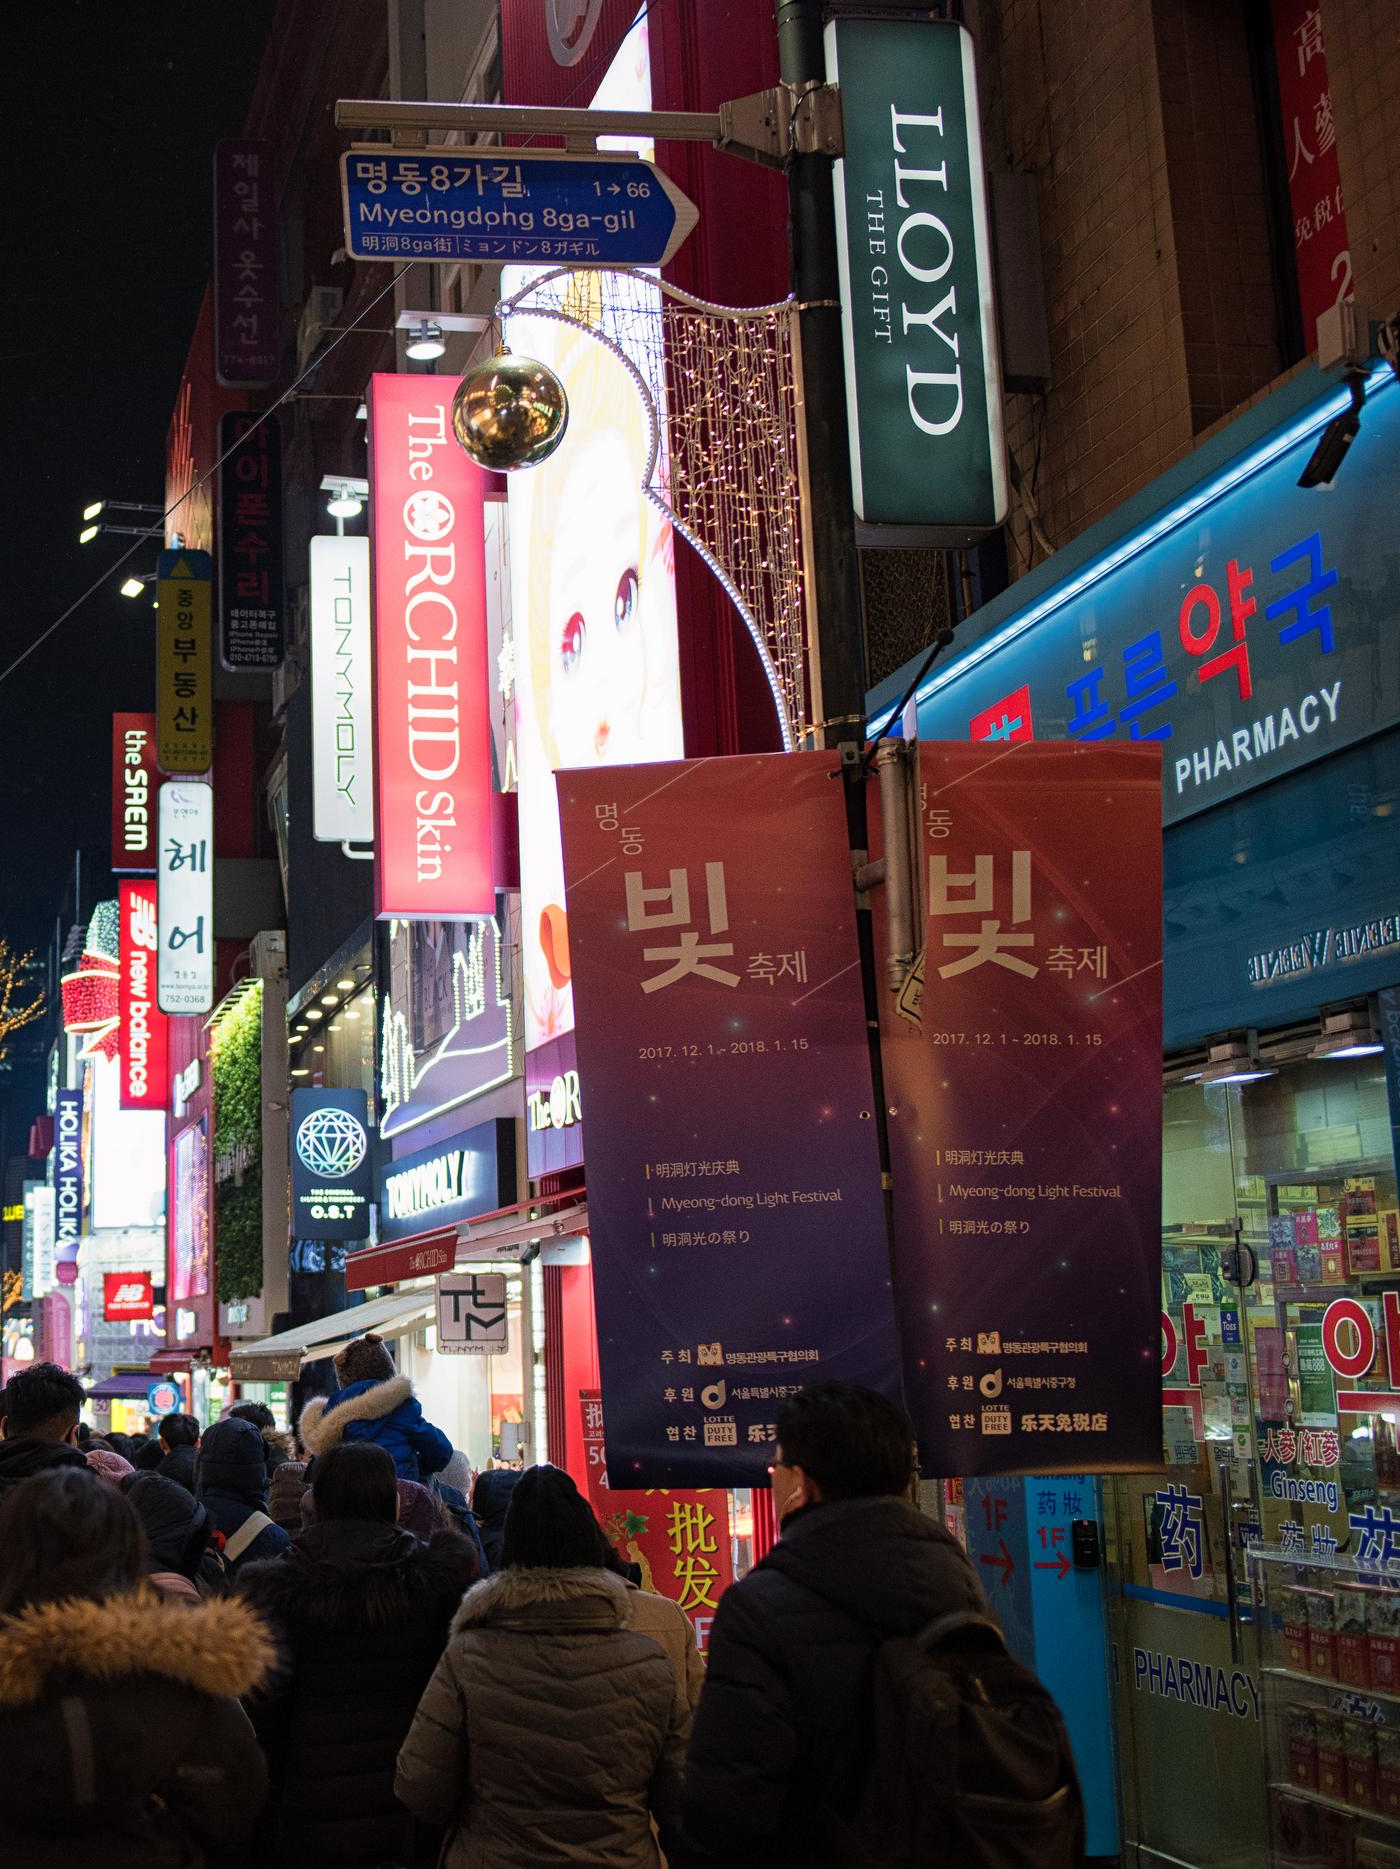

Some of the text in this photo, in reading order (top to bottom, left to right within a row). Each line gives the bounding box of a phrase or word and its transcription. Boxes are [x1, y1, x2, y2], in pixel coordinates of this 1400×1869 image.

[356, 161, 524, 198] 명동8가길
[593, 181, 651, 198] 1 66
[359, 203, 636, 233] Myeongdong 8ga-gil
[361, 234, 452, 254] 明洞8ga街
[461, 238, 600, 257] ミョンドン8ガギル
[865, 190, 893, 345] THE GIFT
[890, 103, 964, 437] LLOYD
[400, 404, 461, 884] The ORCHID Skin
[332, 566, 357, 808] TONYMOLY
[1175, 682, 1342, 793] PHARMACY
[124, 729, 150, 852] the SAEM
[163, 838, 207, 955] 헤어
[928, 850, 1108, 981] 빛 축제
[623, 861, 808, 994] 빛 축제
[128, 950, 149, 1098] new balance
[639, 1046, 677, 1060] 2017.
[682, 1045, 702, 1058] 12.
[730, 1041, 769, 1056] 2018.
[792, 1038, 809, 1050] 15
[932, 1032, 971, 1047] 2017.
[975, 1032, 997, 1047] 12.
[1023, 1032, 1061, 1047] 2018.
[1086, 1032, 1103, 1047] 15
[655, 1159, 741, 1178] 明洞灯光庆典
[944, 1150, 1025, 1167] 明洞灯光庆典
[58, 1100, 78, 1246] HOLIKA HOLIKA
[385, 1150, 470, 1220] TONYMOLY
[949, 1183, 1122, 1201] Myeong-dong Light Festival
[661, 1187, 843, 1211] Myeong-dong Light Festival
[310, 1204, 356, 1220] O.S.T
[949, 1220, 1031, 1235] 明洞光の祭り
[662, 1229, 750, 1248] 明洞光の祭り
[945, 1337, 972, 1352] 주최
[660, 1348, 692, 1365] 주최
[947, 1375, 975, 1390] 후원
[663, 1386, 695, 1403] 후원
[981, 1404, 1010, 1412] LOTTE
[703, 1415, 736, 1423] LOTTE
[948, 1413, 976, 1430] 협찬
[984, 1414, 1009, 1423] DUTY
[984, 1422, 1009, 1431] FREE
[1020, 1412, 1109, 1433] 乐天免税店
[665, 1424, 697, 1442] 협찬
[706, 1425, 735, 1434] DUTY
[707, 1433, 734, 1443] FREE
[1271, 1470, 1338, 1513] Ginseng
[1035, 1526, 1066, 1549] 1F
[666, 1501, 719, 1612] 批发
[1133, 1647, 1261, 1722] PHARMACY
